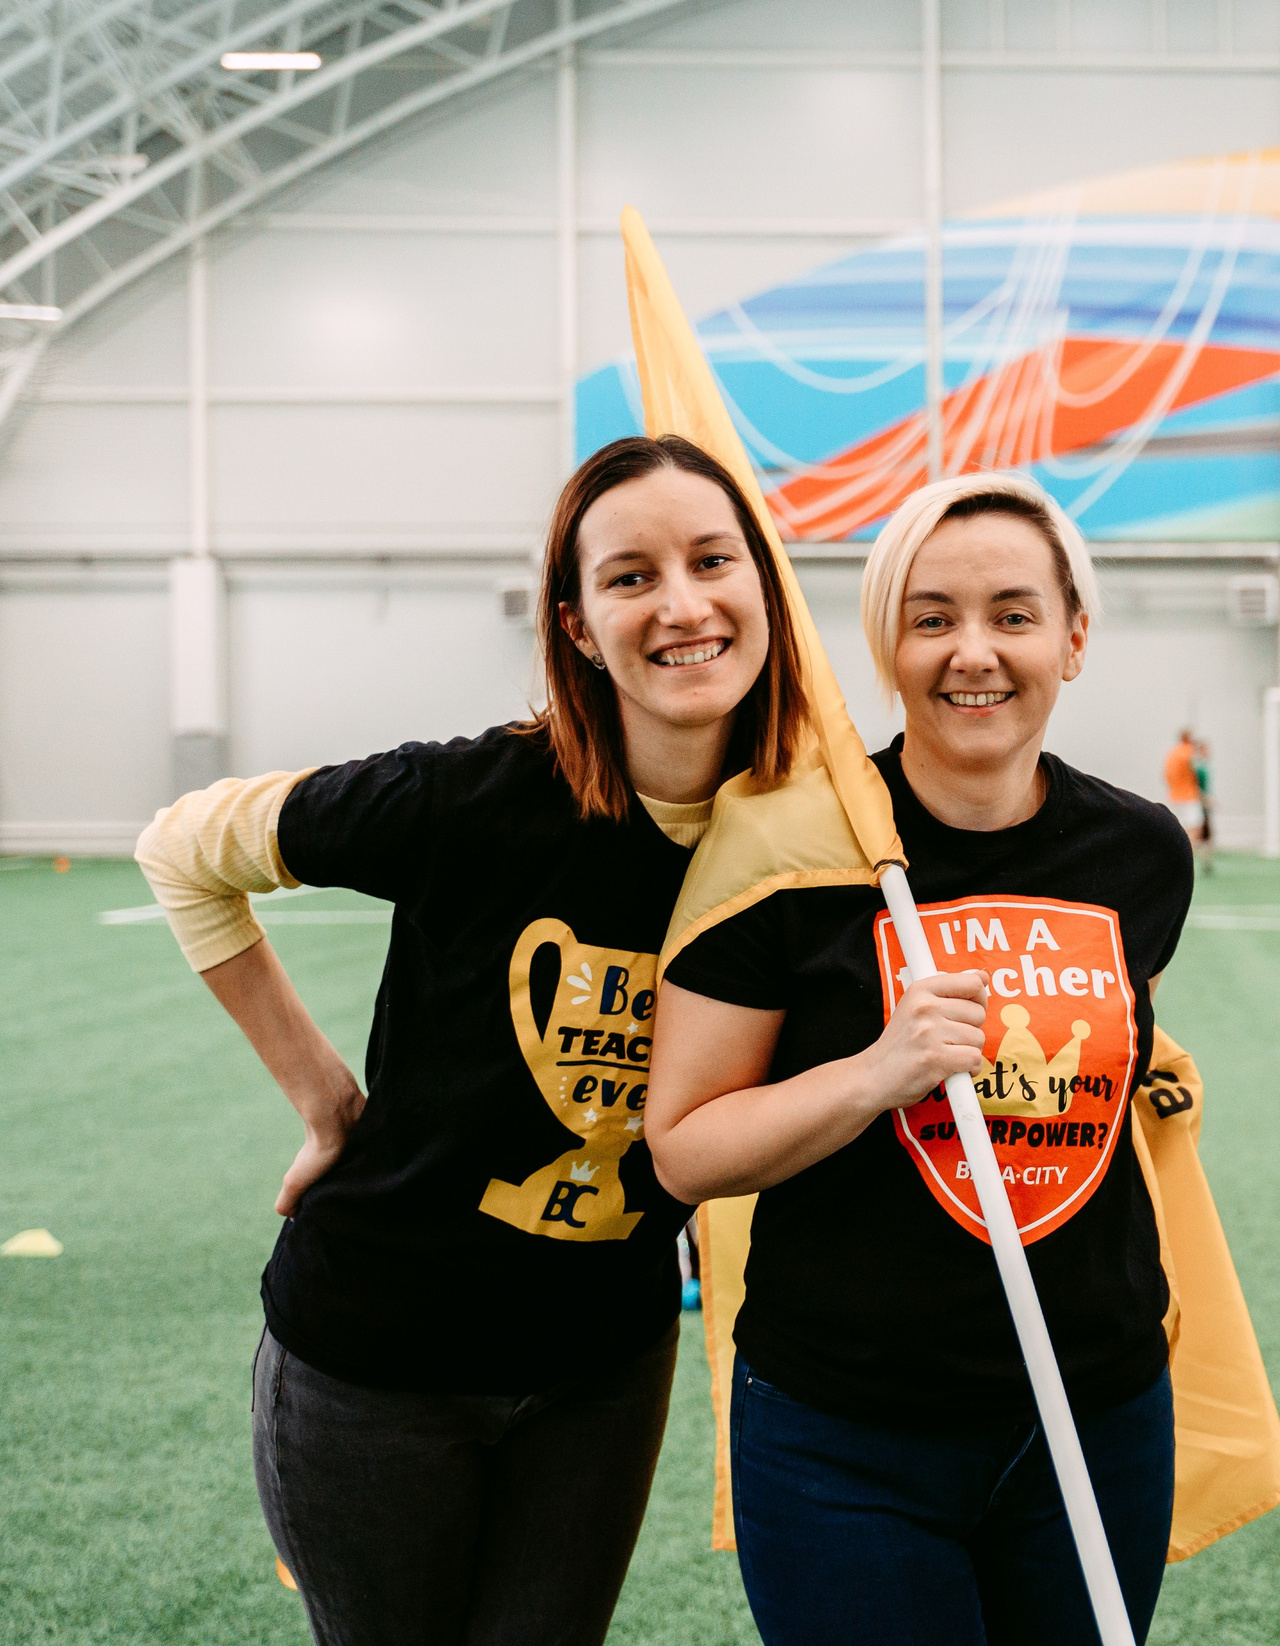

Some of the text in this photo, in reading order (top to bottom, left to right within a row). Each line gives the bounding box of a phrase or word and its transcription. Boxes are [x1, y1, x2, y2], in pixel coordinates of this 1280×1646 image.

[938, 917, 1062, 955] I'M A
[1049, 1074, 1118, 1112] your
[919, 1120, 1109, 1150] SURPOWER?
[540, 1180, 600, 1229] BC
